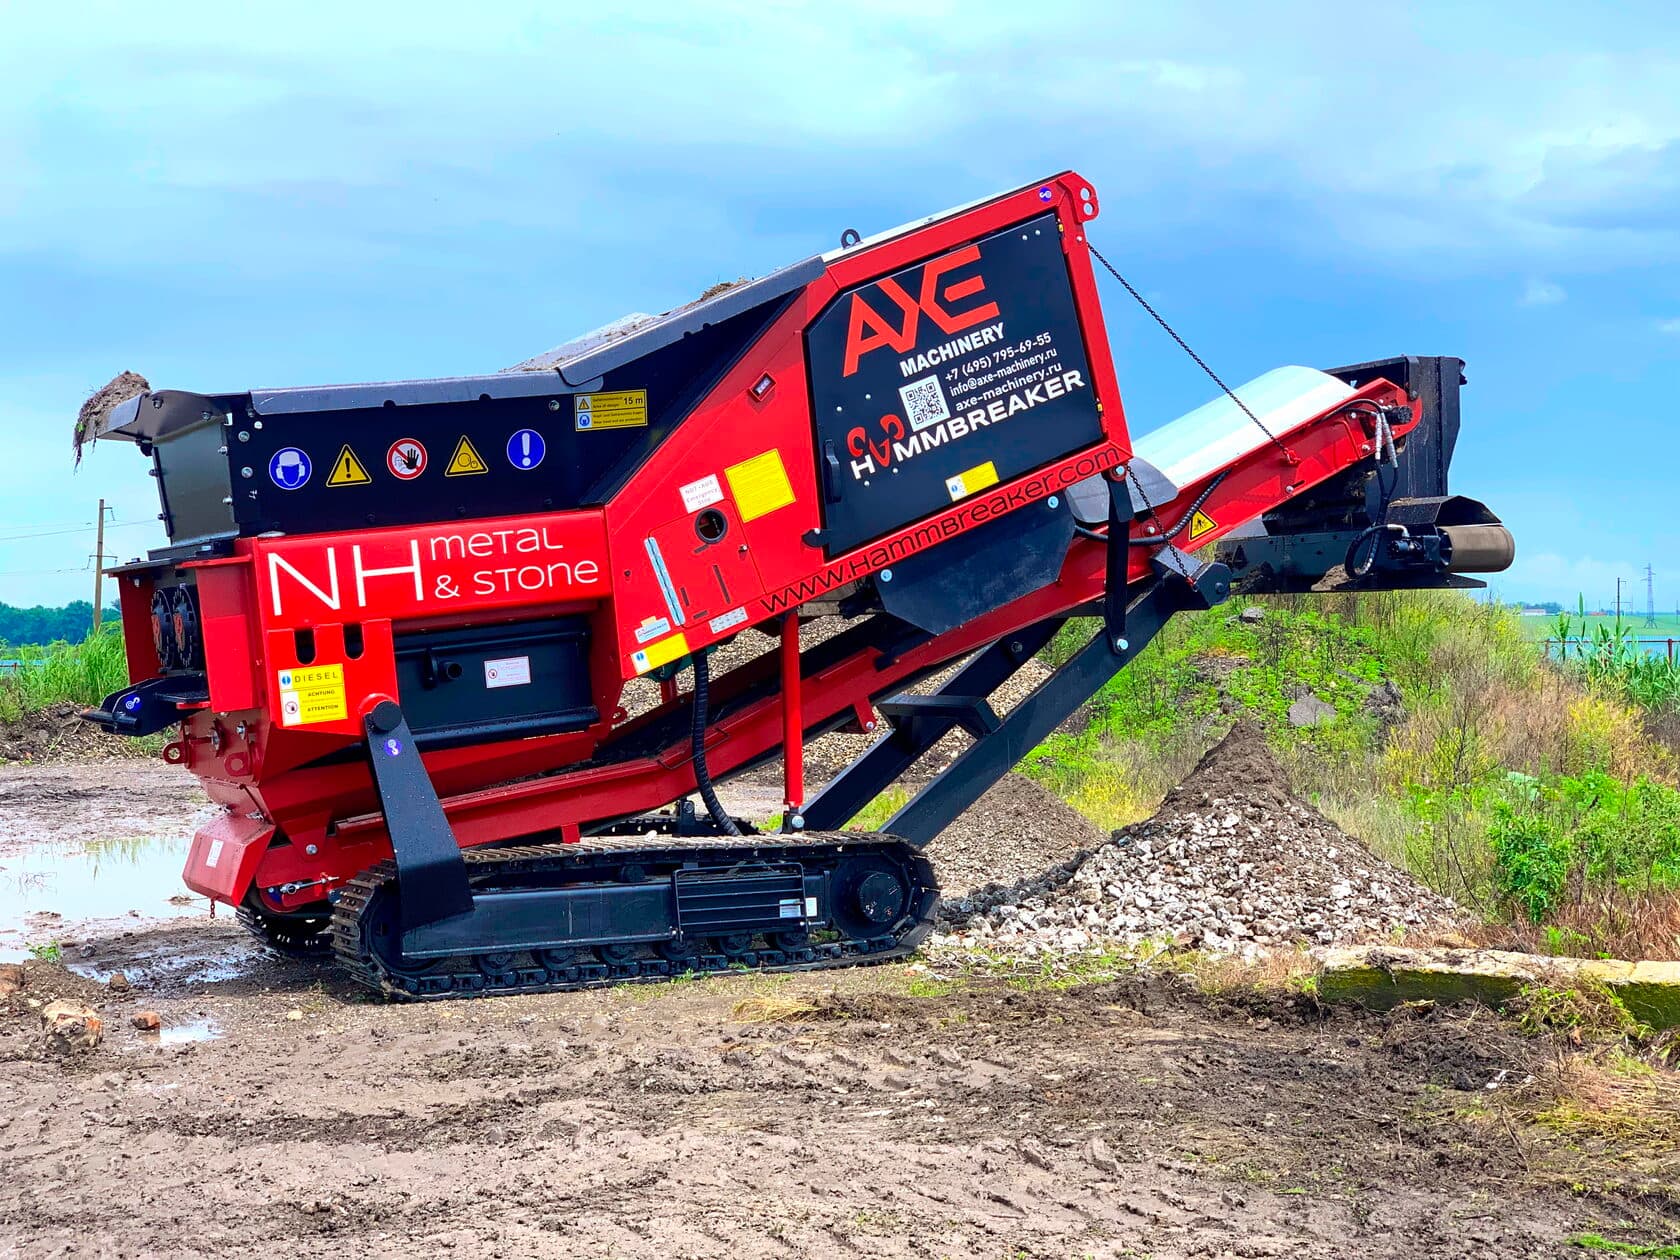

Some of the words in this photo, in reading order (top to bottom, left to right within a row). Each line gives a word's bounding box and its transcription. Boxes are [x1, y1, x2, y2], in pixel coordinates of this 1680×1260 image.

[843, 245, 1000, 377] AXE
[900, 322, 1004, 377] MACHINERY
[945, 368, 959, 382] +7
[962, 356, 992, 377] (495)
[993, 332, 1052, 364] 795-69-55
[949, 348, 1058, 398] info@axe-machinery.ru
[623, 397, 634, 405] 15
[955, 362, 1063, 412] axe-machinery.ru
[267, 539, 424, 616] NH
[434, 574, 461, 598] &
[294, 671, 338, 683] DIESEL
[308, 689, 335, 697] ACHTUNG
[307, 704, 339, 712] ATTENTION
